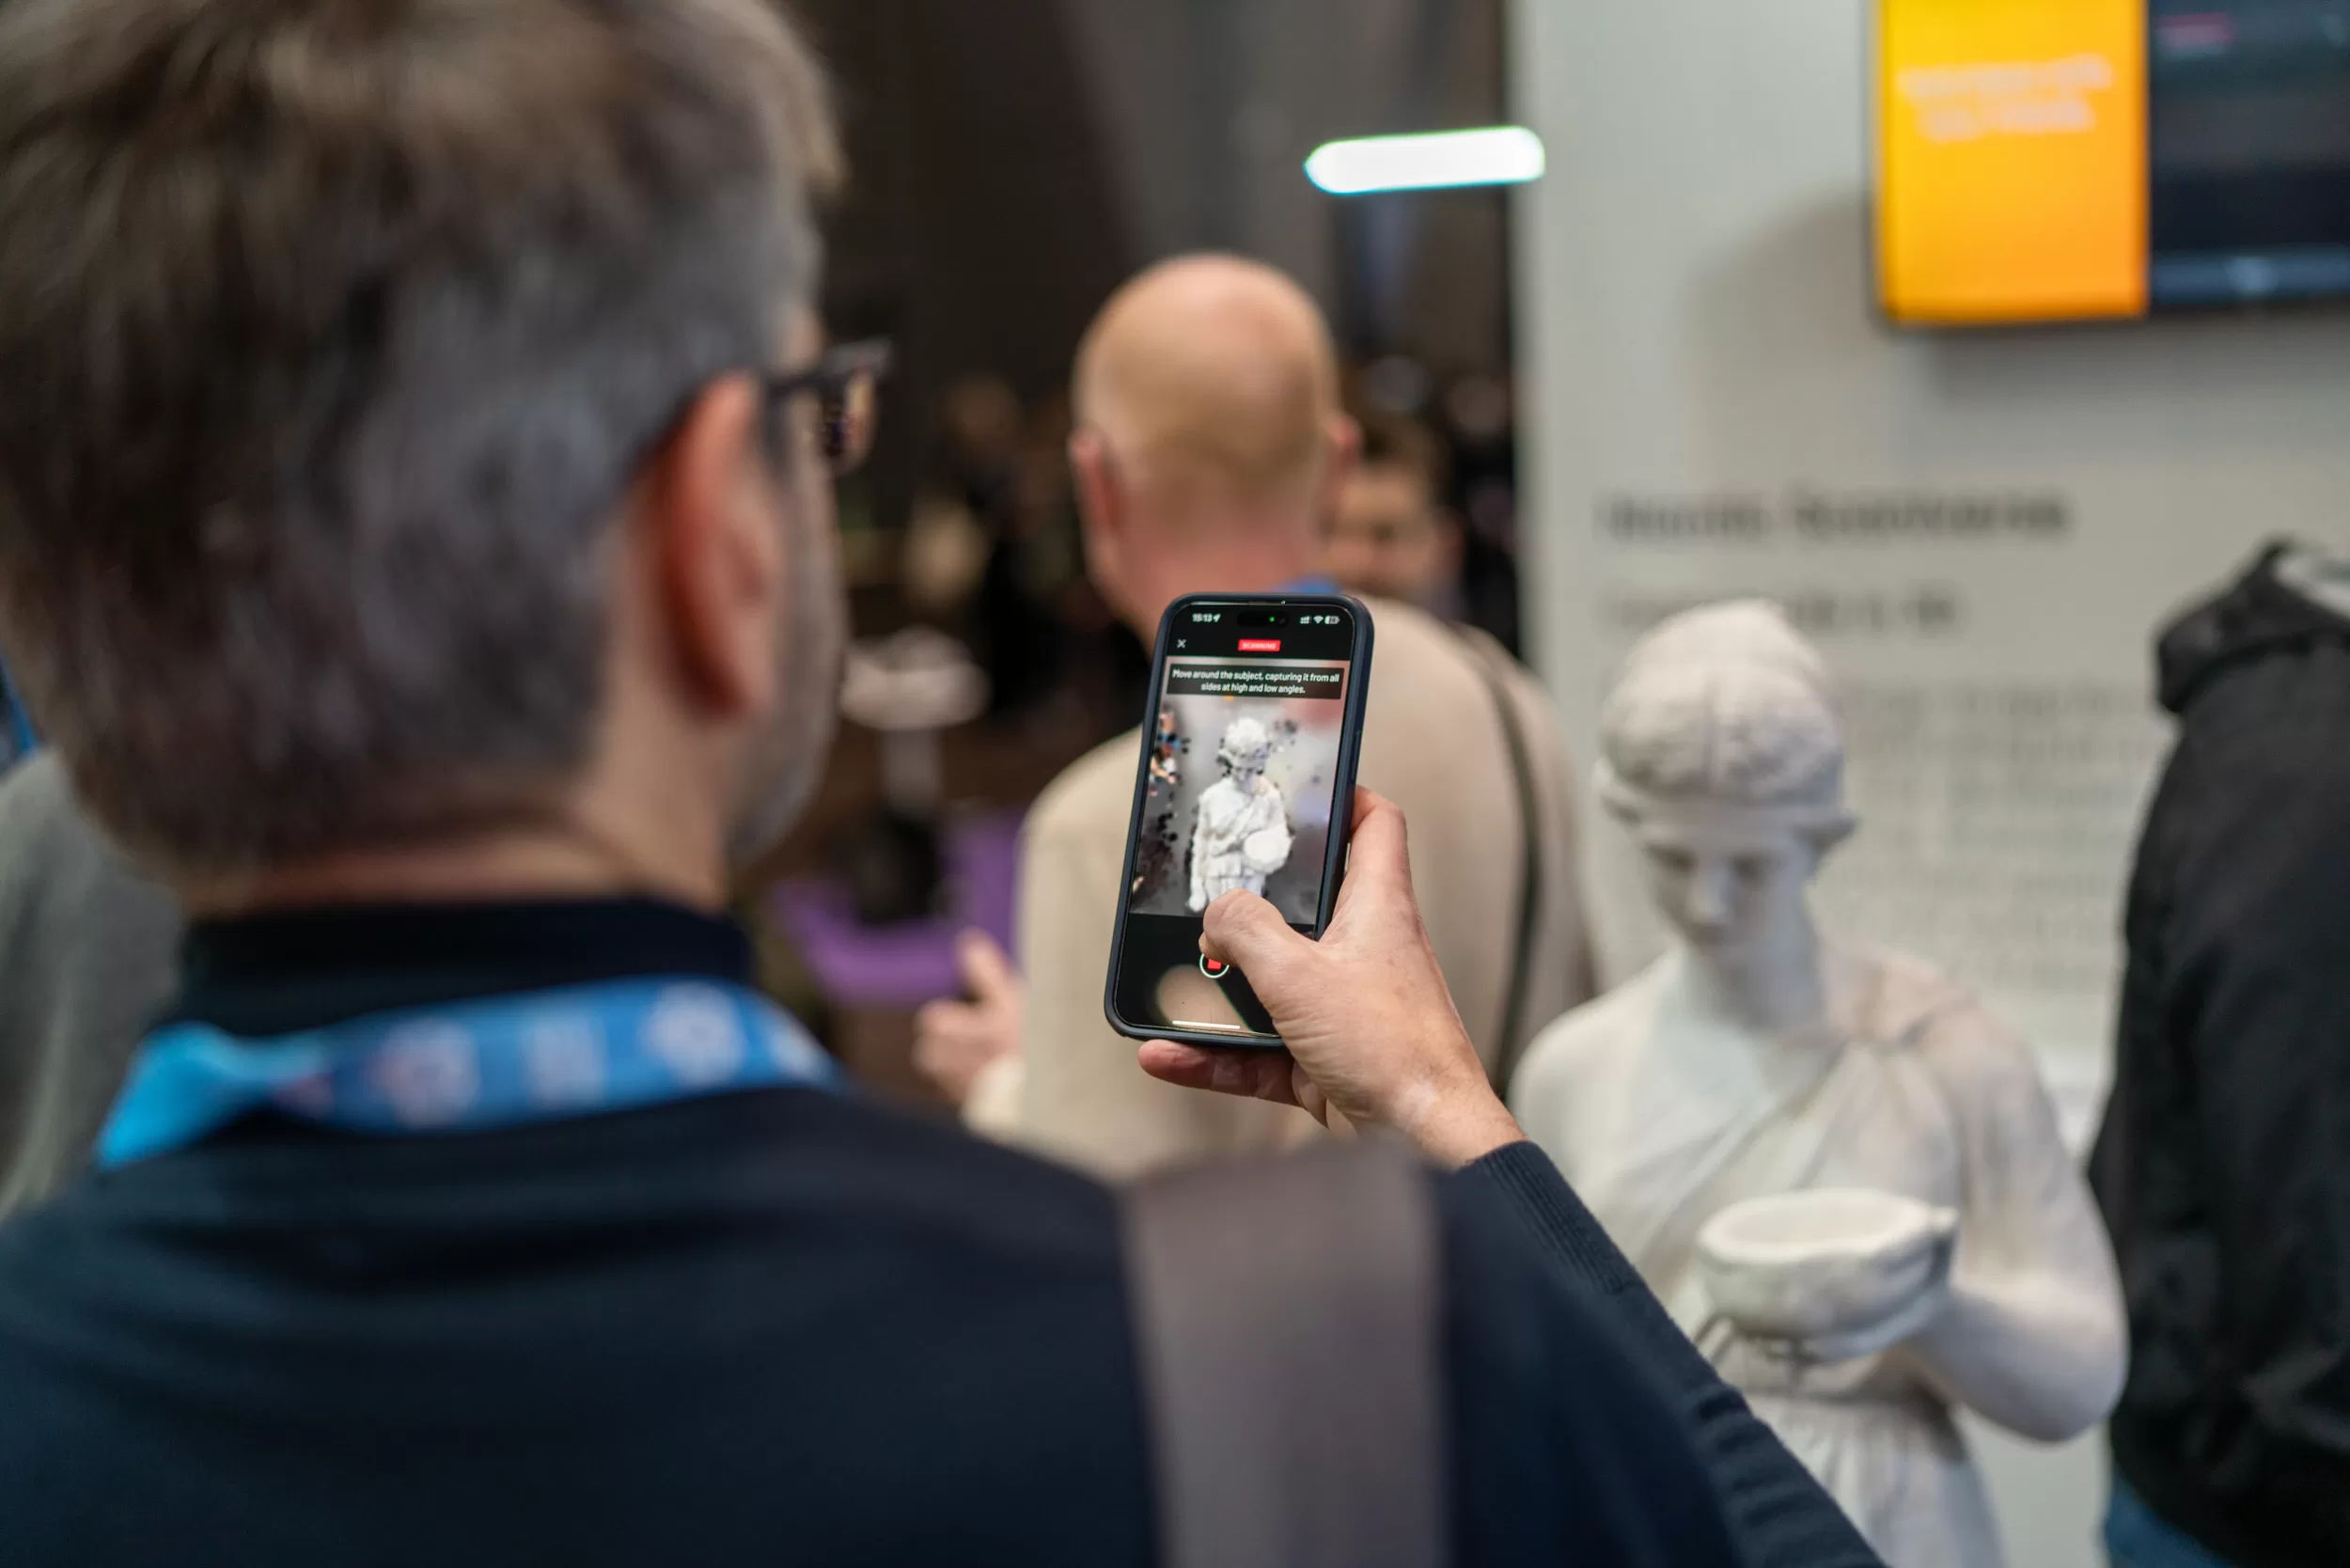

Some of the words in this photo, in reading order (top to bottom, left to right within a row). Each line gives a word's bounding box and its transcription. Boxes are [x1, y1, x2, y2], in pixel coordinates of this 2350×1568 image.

[1172, 668, 1192, 679] Move
[1193, 670, 1218, 679] around
[1220, 670, 1232, 680] the
[1265, 672, 1301, 683] capturing
[1303, 673, 1308, 682] it
[1309, 672, 1328, 682] from
[1329, 673, 1340, 682] all
[1201, 682, 1221, 692] sides
[1222, 683, 1230, 692] at
[1231, 682, 1248, 694] high
[1248, 683, 1262, 692] and
[1264, 683, 1277, 693] low
[1278, 684, 1306, 696] angles.
